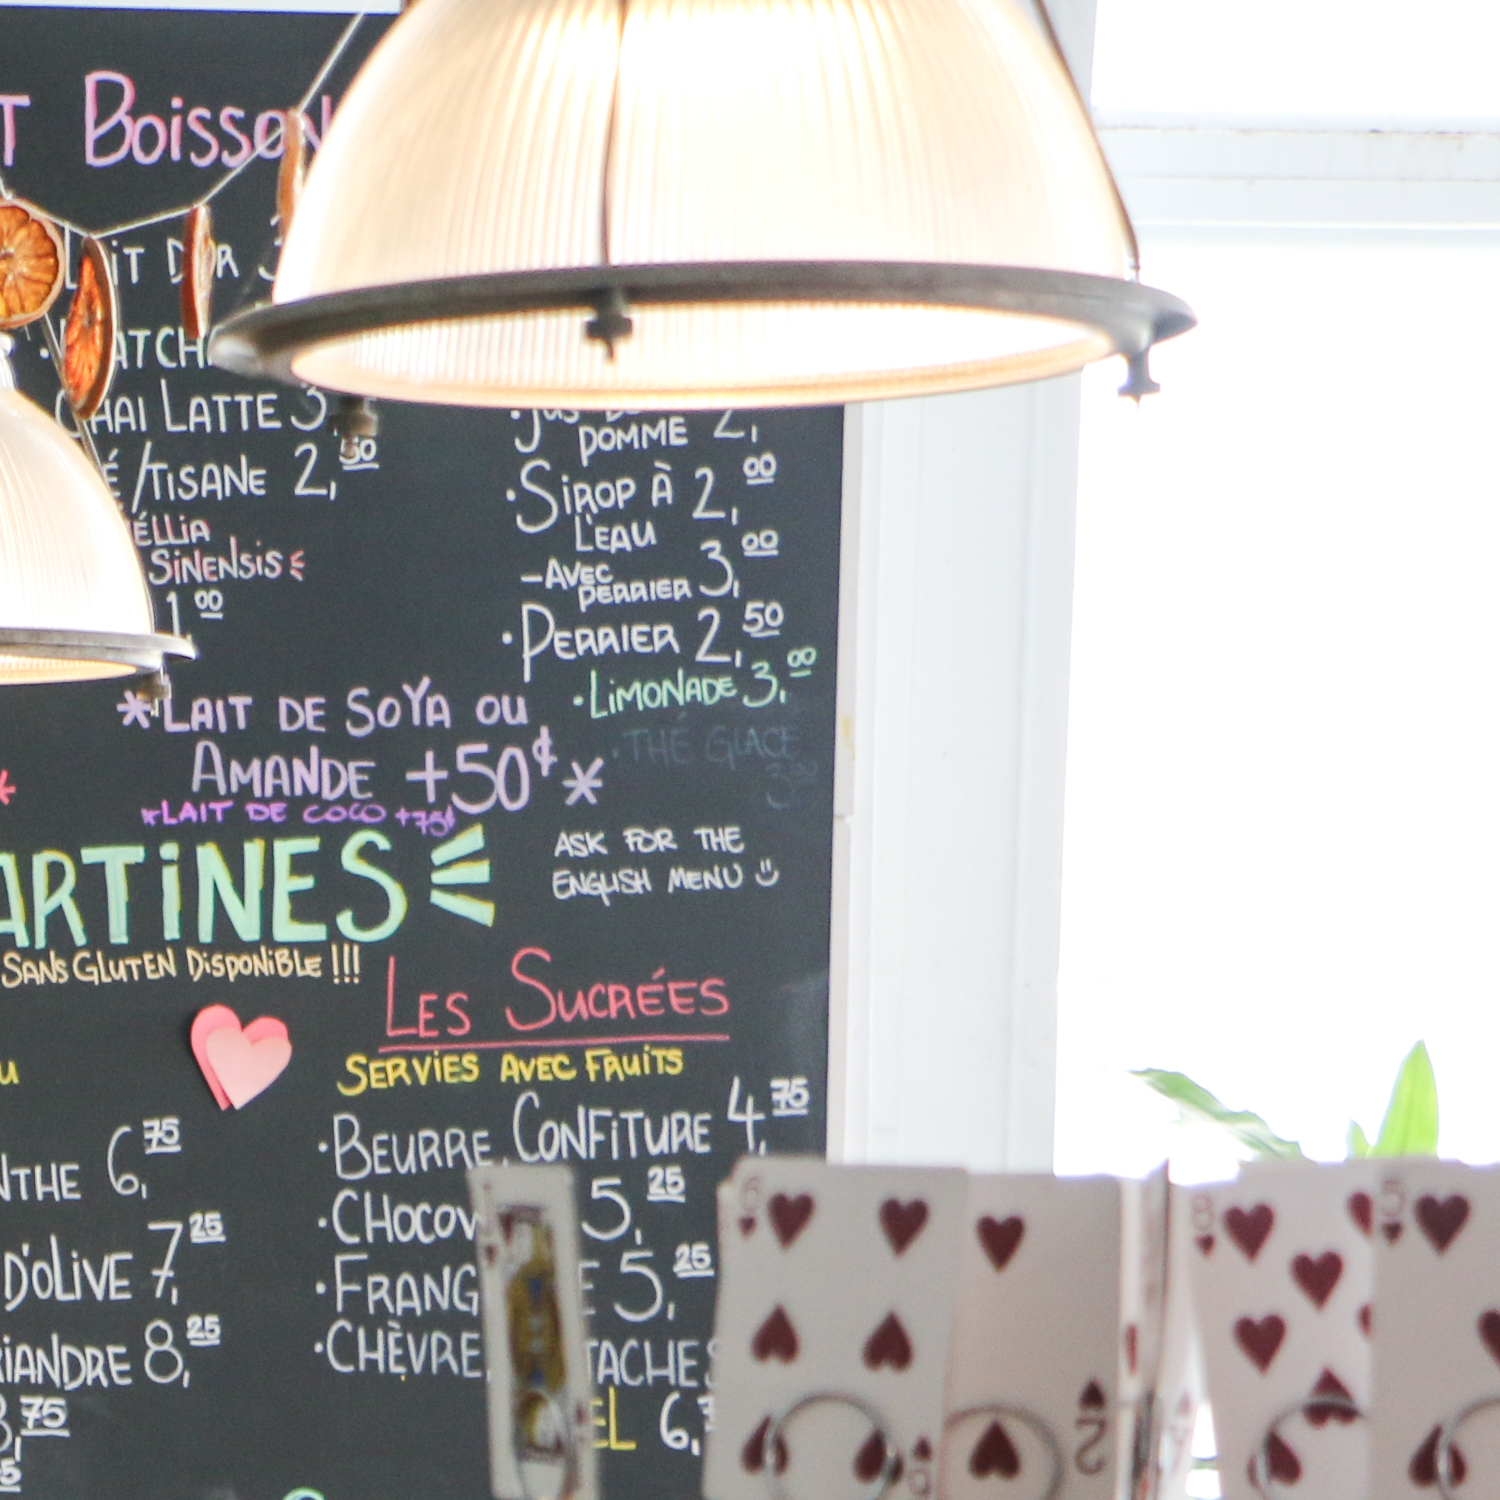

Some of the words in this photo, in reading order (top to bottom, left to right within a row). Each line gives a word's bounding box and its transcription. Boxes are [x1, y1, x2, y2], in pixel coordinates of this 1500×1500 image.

[160, 378, 282, 433] LATTE
[578, 415, 689, 468] POMME
[278, 695, 327, 733] DE
[345, 676, 452, 738] SOYA
[475, 694, 530, 728] OU
[191, 740, 377, 801] AMANDE
[246, 802, 287, 824] DE
[302, 803, 387, 825] COCO
[553, 830, 608, 858] ASK
[621, 826, 679, 853] FOR
[692, 825, 747, 854] THE
[552, 867, 653, 907] ENGLISH
[667, 863, 745, 894] MENU
[0, 950, 70, 990] SANS
[72, 947, 177, 987] GLUTEN
[385, 955, 473, 1039] LES
[504, 946, 731, 1032] SUCRÉES
[499, 1051, 577, 1087] AVEC
